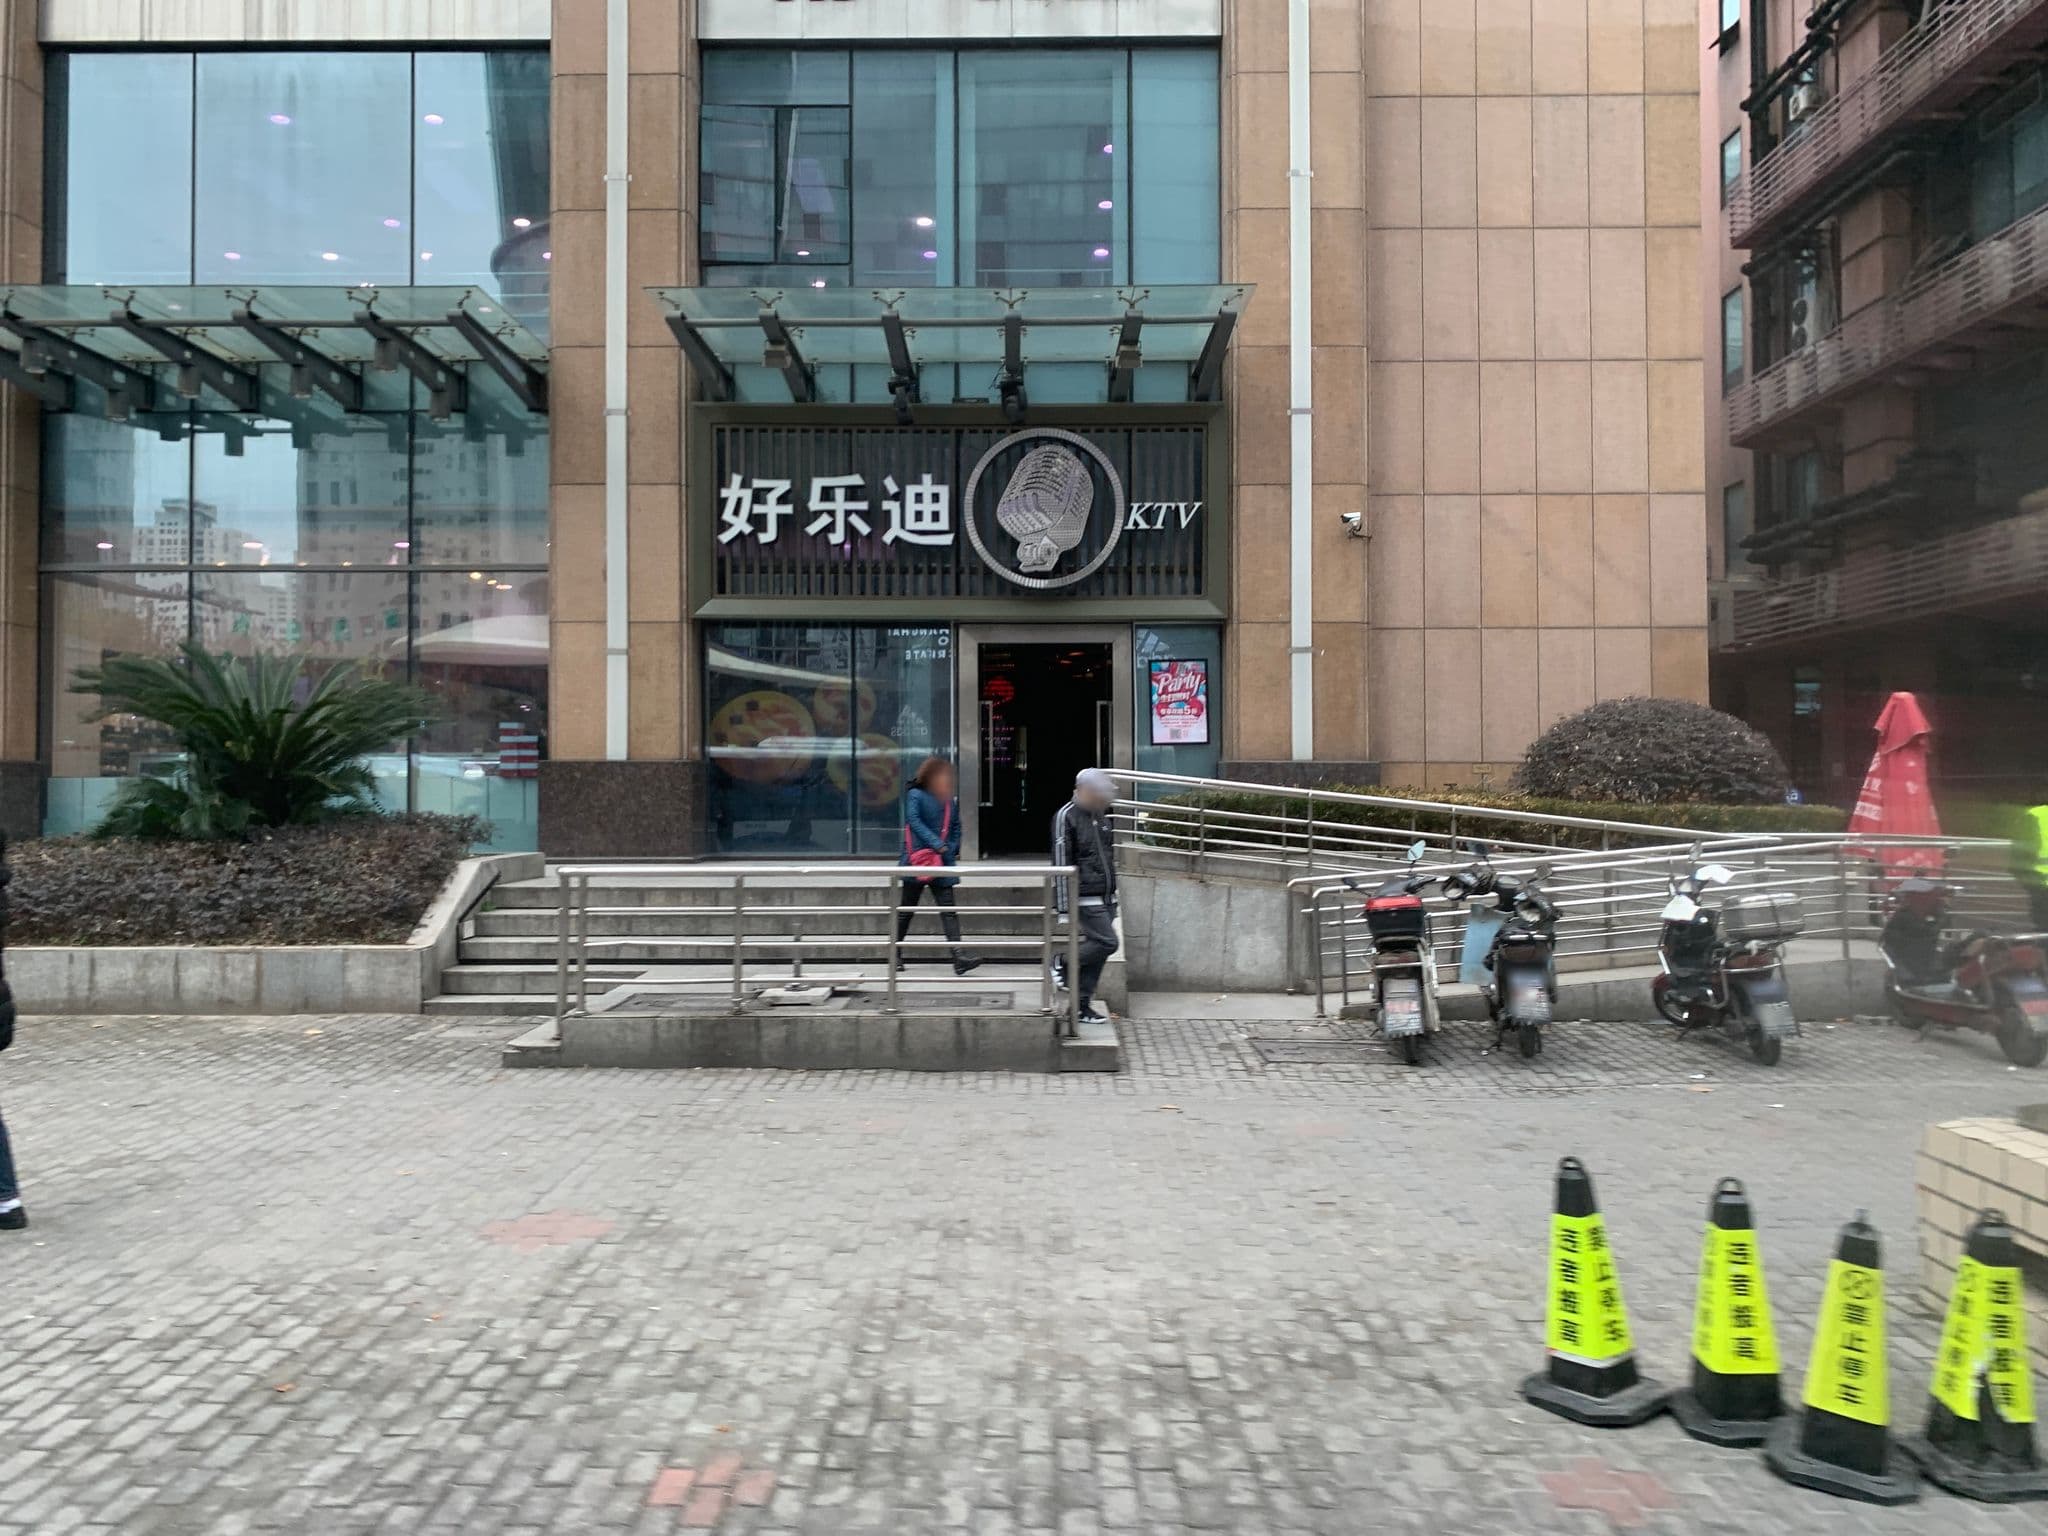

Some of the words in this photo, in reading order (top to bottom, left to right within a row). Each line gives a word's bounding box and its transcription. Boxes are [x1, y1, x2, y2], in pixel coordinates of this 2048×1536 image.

[717, 472, 956, 547] 好乐迪
[1124, 500, 1203, 531] KTV
[1157, 671, 1203, 698] Party
